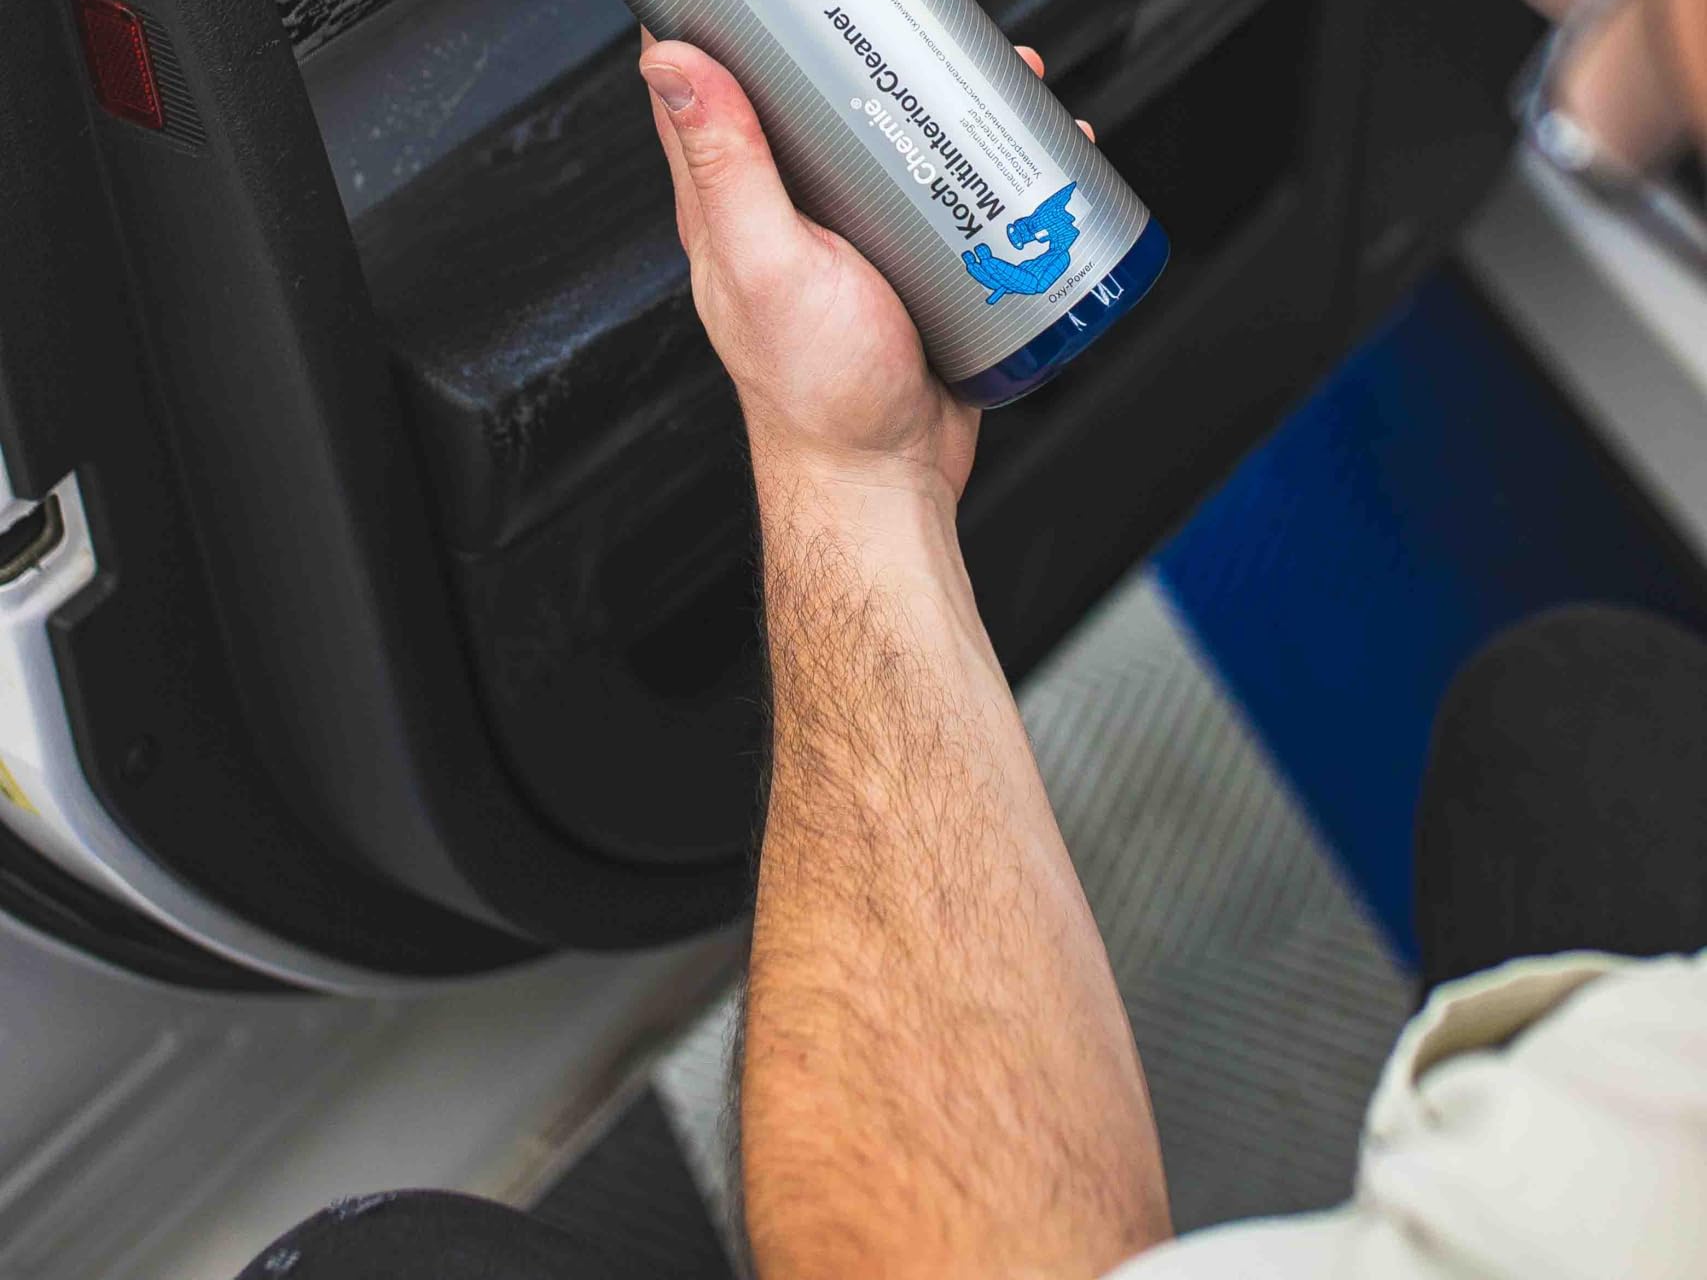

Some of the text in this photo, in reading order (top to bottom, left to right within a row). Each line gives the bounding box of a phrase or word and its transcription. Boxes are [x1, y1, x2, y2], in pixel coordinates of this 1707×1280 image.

[918, 30, 946, 62] салона
[824, 7, 1006, 221] MultiInteriorCleaner
[945, 61, 986, 110] очиститель
[960, 118, 1024, 196] Innenraumreiniger
[984, 109, 1043, 179] Универсальный
[996, 142, 1034, 187] Nettoyant
